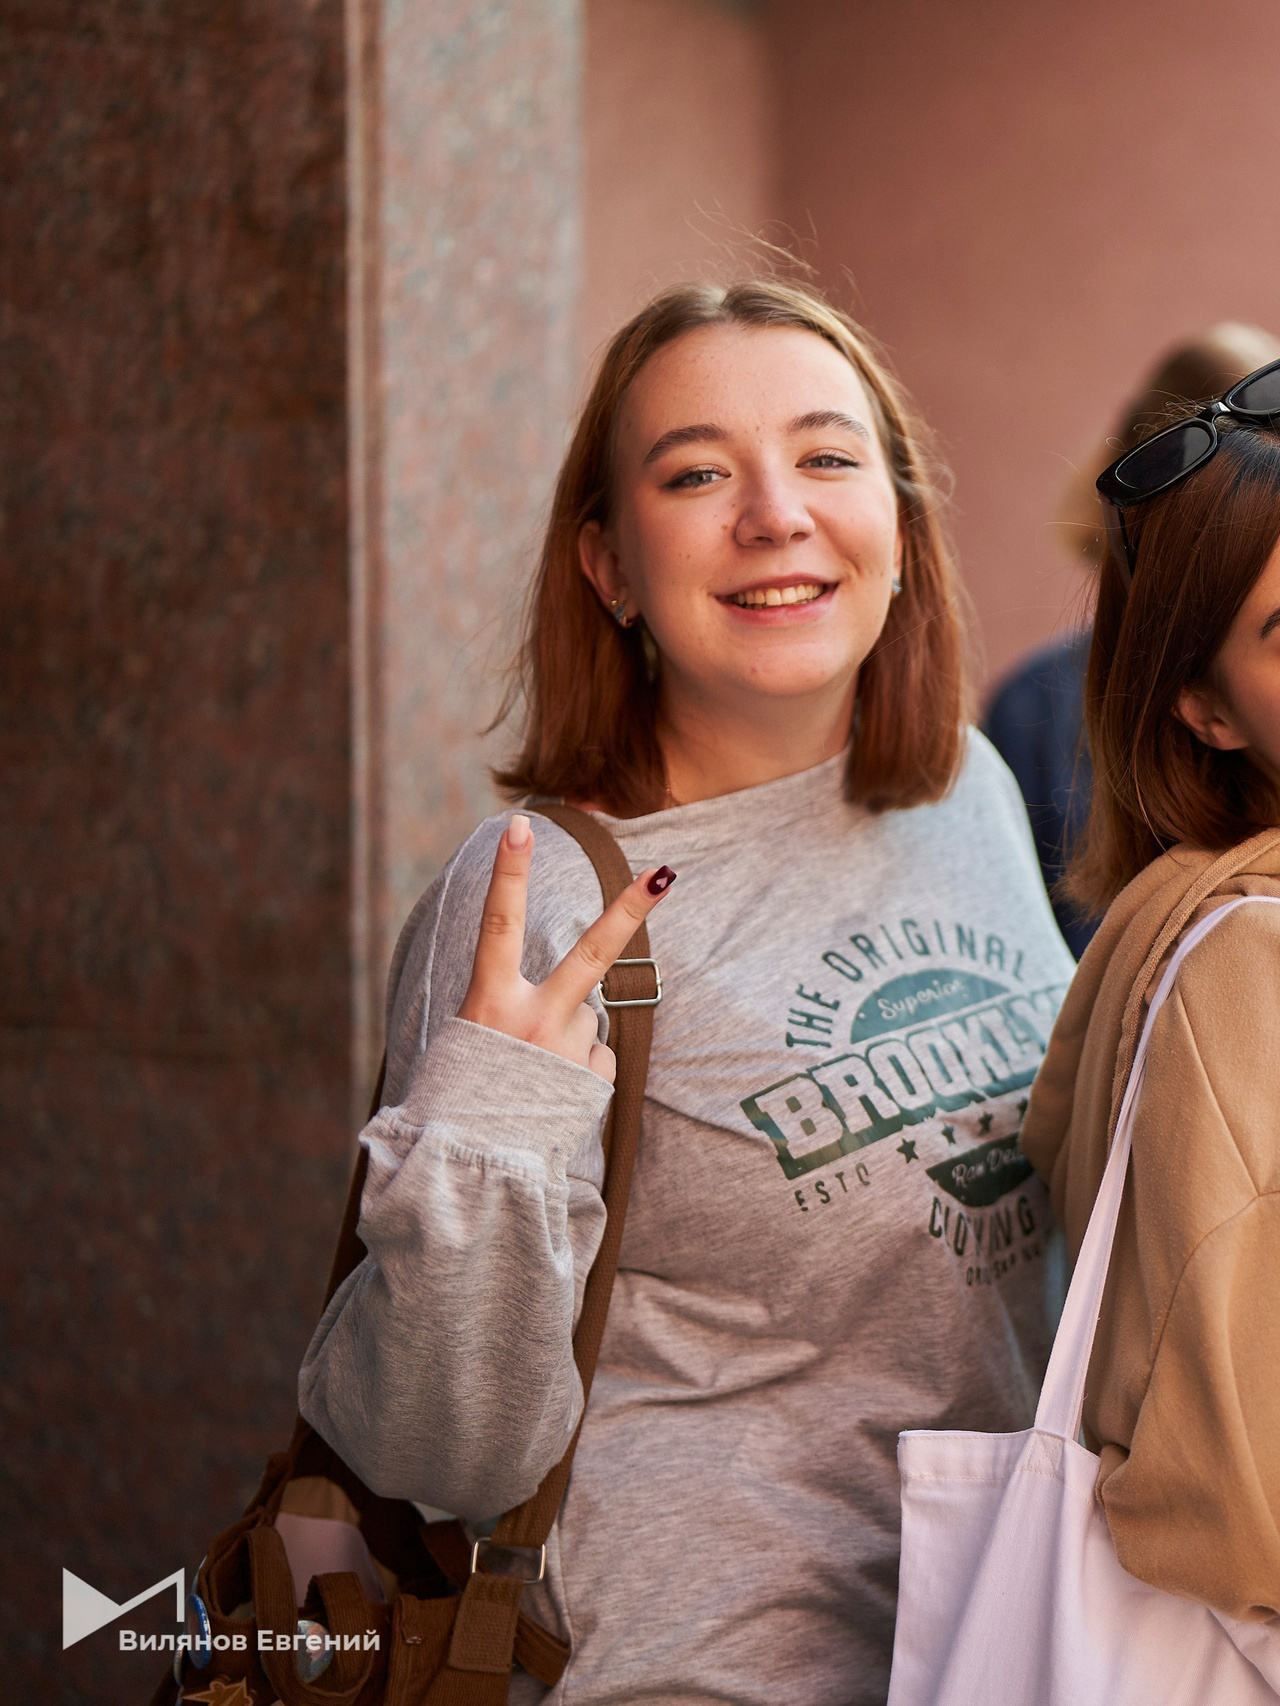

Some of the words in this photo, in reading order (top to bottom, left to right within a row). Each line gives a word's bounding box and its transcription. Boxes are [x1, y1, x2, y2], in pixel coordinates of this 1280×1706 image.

[785, 983, 840, 1048] THE
[822, 918, 1024, 982] ORIGINAL
[740, 985, 1068, 1180] BROOKLY
